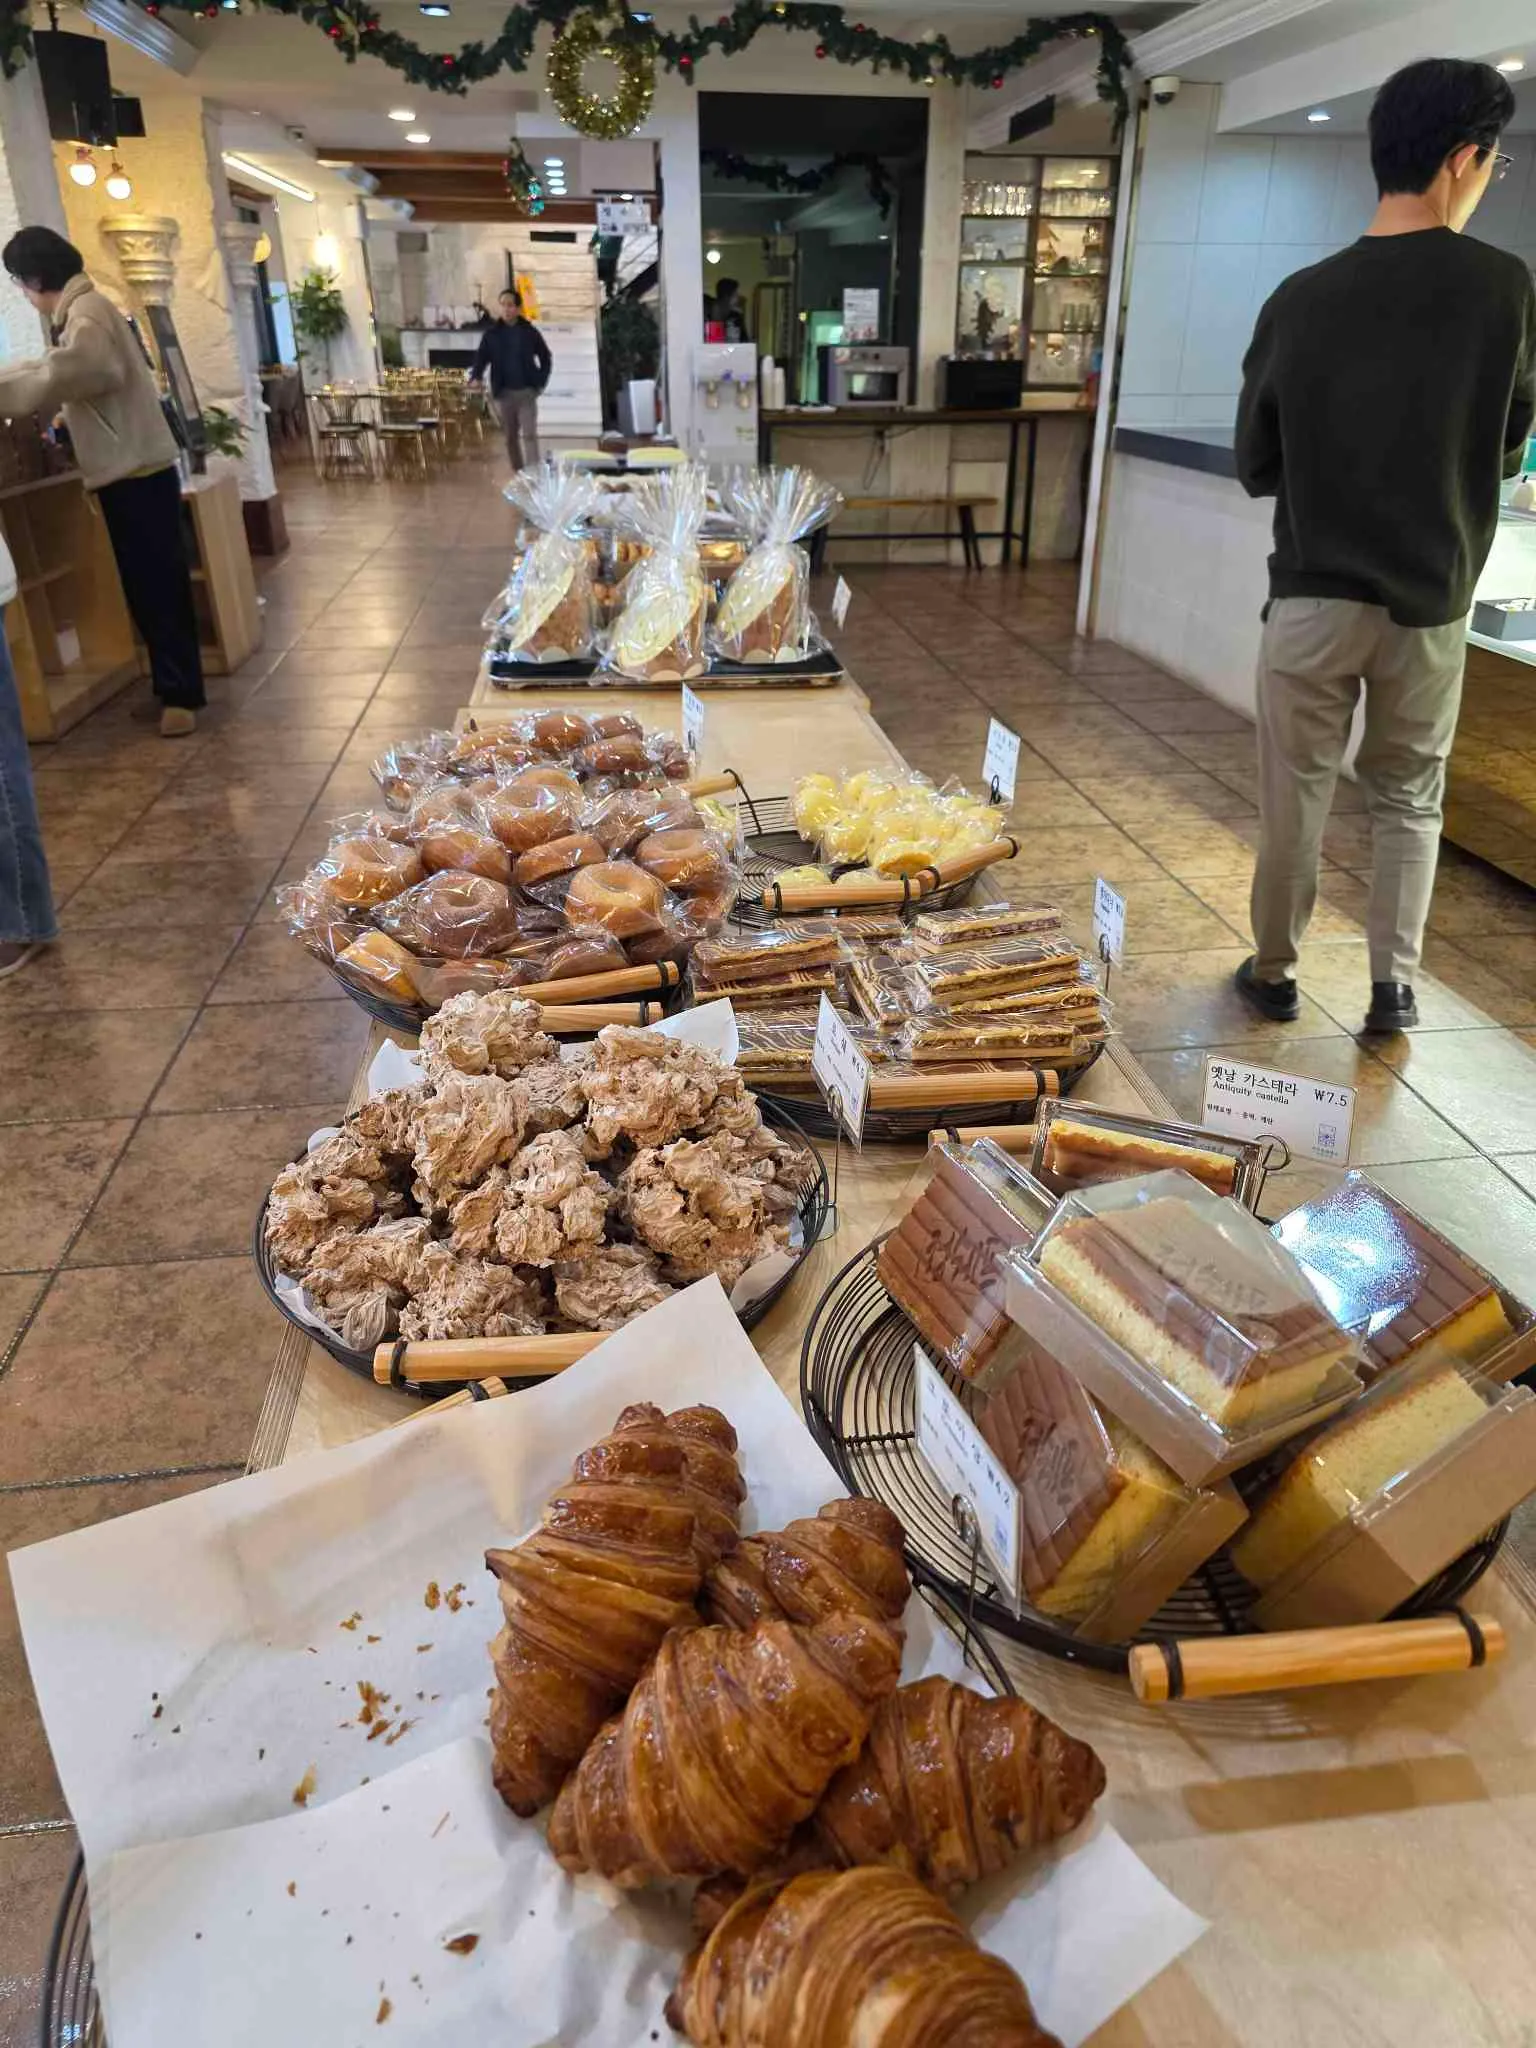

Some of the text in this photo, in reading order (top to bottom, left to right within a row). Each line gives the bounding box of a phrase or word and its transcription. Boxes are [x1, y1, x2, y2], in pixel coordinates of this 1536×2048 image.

[1211, 1065, 1299, 1097] 옛날 카스테라
[1213, 1081, 1252, 1097] Antiquity
